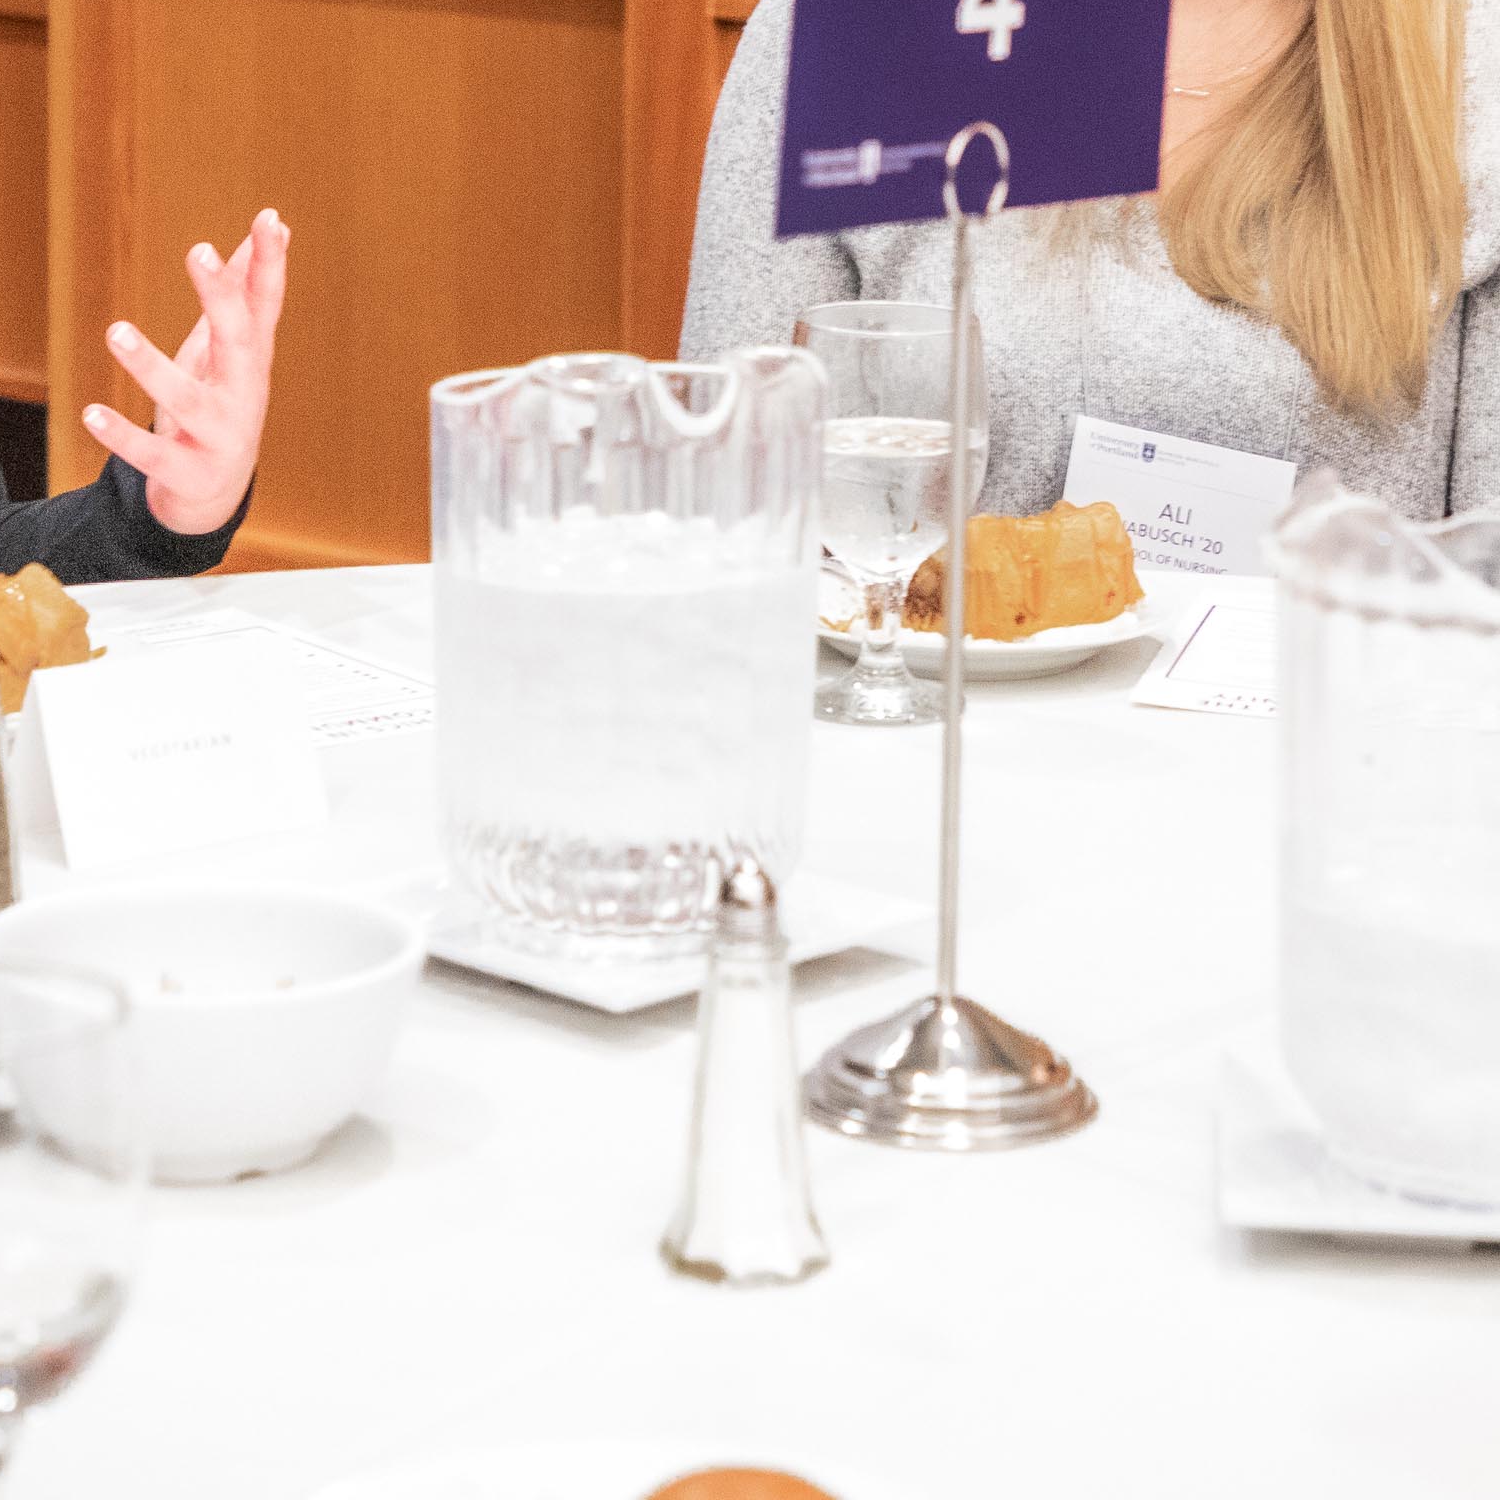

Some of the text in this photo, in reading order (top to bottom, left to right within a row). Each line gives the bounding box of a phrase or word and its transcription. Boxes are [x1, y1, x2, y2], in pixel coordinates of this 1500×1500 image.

[1158, 503, 1193, 526] ALI
[1199, 535, 1224, 555] '20
[1156, 553, 1172, 565] OF
[954, 915, 1027, 1062] 4
